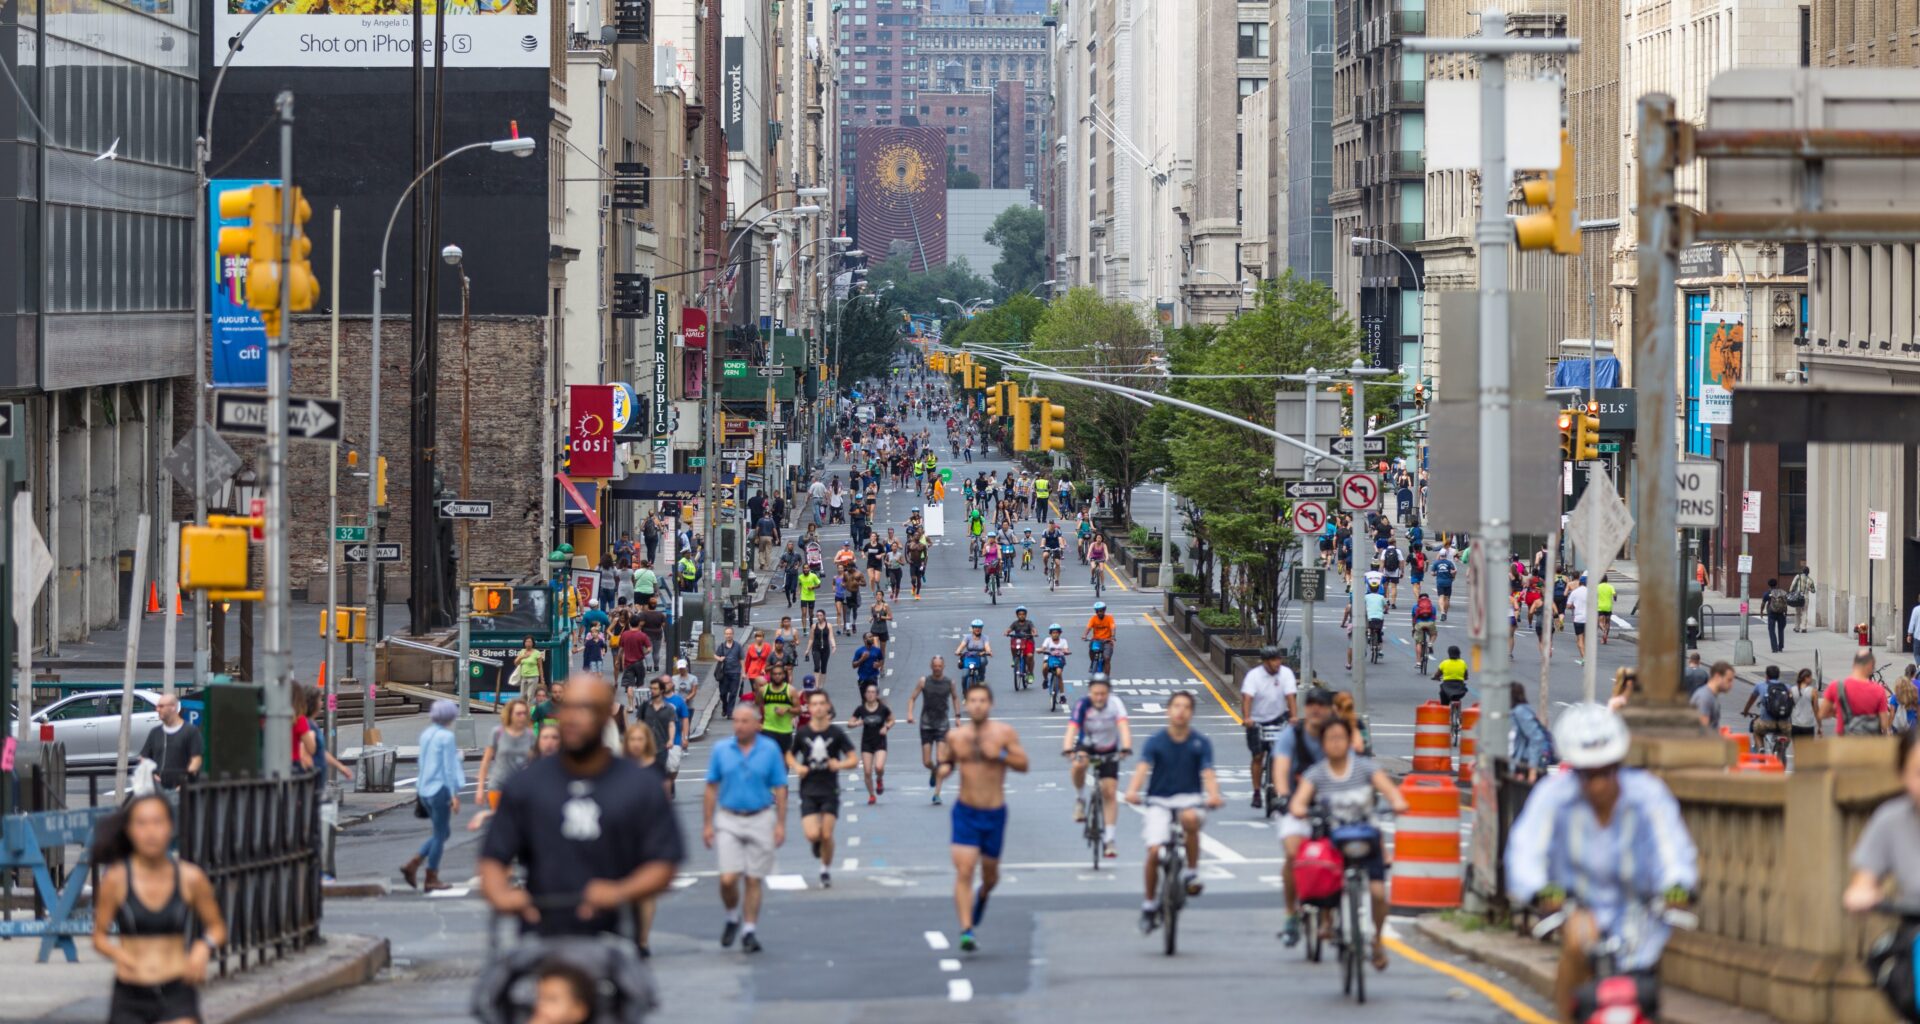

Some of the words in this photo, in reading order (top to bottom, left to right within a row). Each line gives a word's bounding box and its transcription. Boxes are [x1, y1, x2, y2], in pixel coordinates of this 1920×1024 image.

[361, 19, 371, 28] by
[373, 19, 400, 28] Angela
[402, 19, 411, 27] D.
[299, 34, 340, 53] Shot
[344, 38, 367, 53] on
[727, 64, 742, 124] wework
[217, 316, 249, 324] AUGUST
[656, 293, 666, 345] FIRST
[239, 345, 261, 359] citi
[690, 352, 698, 390] THAI
[655, 352, 666, 433] REPUBLIC
[233, 405, 268, 424] ONE
[288, 410, 325, 427] WAY
[1337, 442, 1353, 450] ONE
[448, 505, 463, 513] ONE
[469, 505, 486, 513] WAY
[340, 528, 353, 539] 32
[352, 549, 369, 557] ONE
[376, 549, 394, 557] WAY
[469, 649, 480, 657] 33
[482, 649, 506, 657] Street
[473, 666, 480, 675] 6
[1063, 678, 1206, 686] TUNNL
